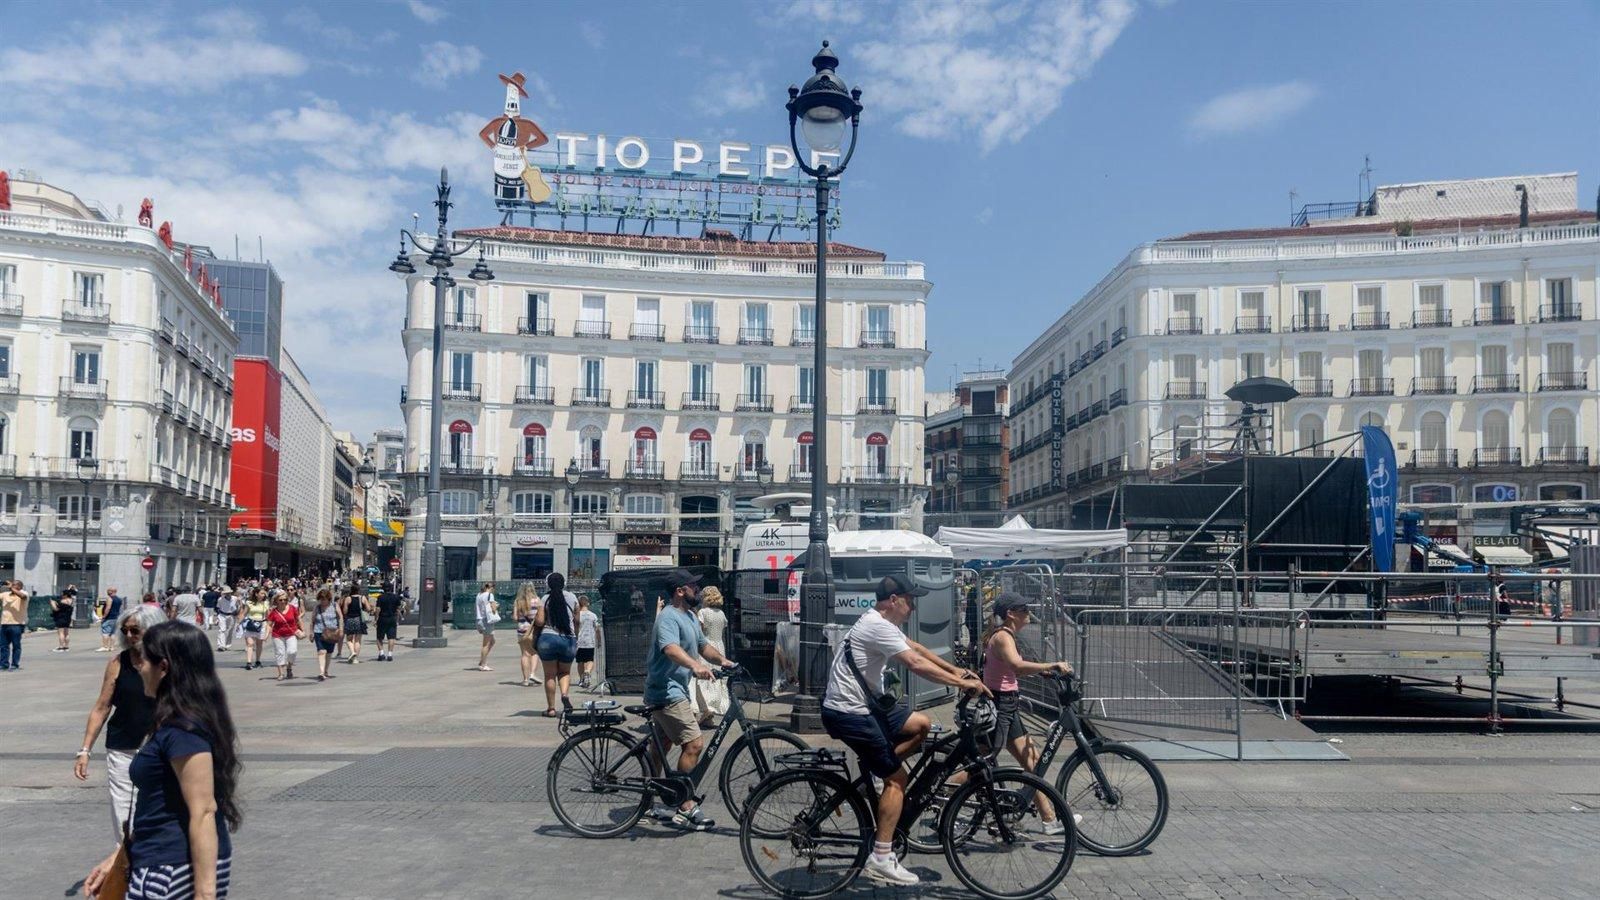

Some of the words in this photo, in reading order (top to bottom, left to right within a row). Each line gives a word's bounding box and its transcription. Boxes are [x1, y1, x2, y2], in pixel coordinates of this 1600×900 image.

[557, 132, 650, 169] TIO
[674, 138, 841, 181] PEPE
[594, 176, 614, 187] DE
[1053, 380, 1061, 425] HOTEL
[1053, 432, 1061, 487] EUROPA
[761, 528, 781, 540] 4K
[1475, 537, 1519, 545] GELATO
